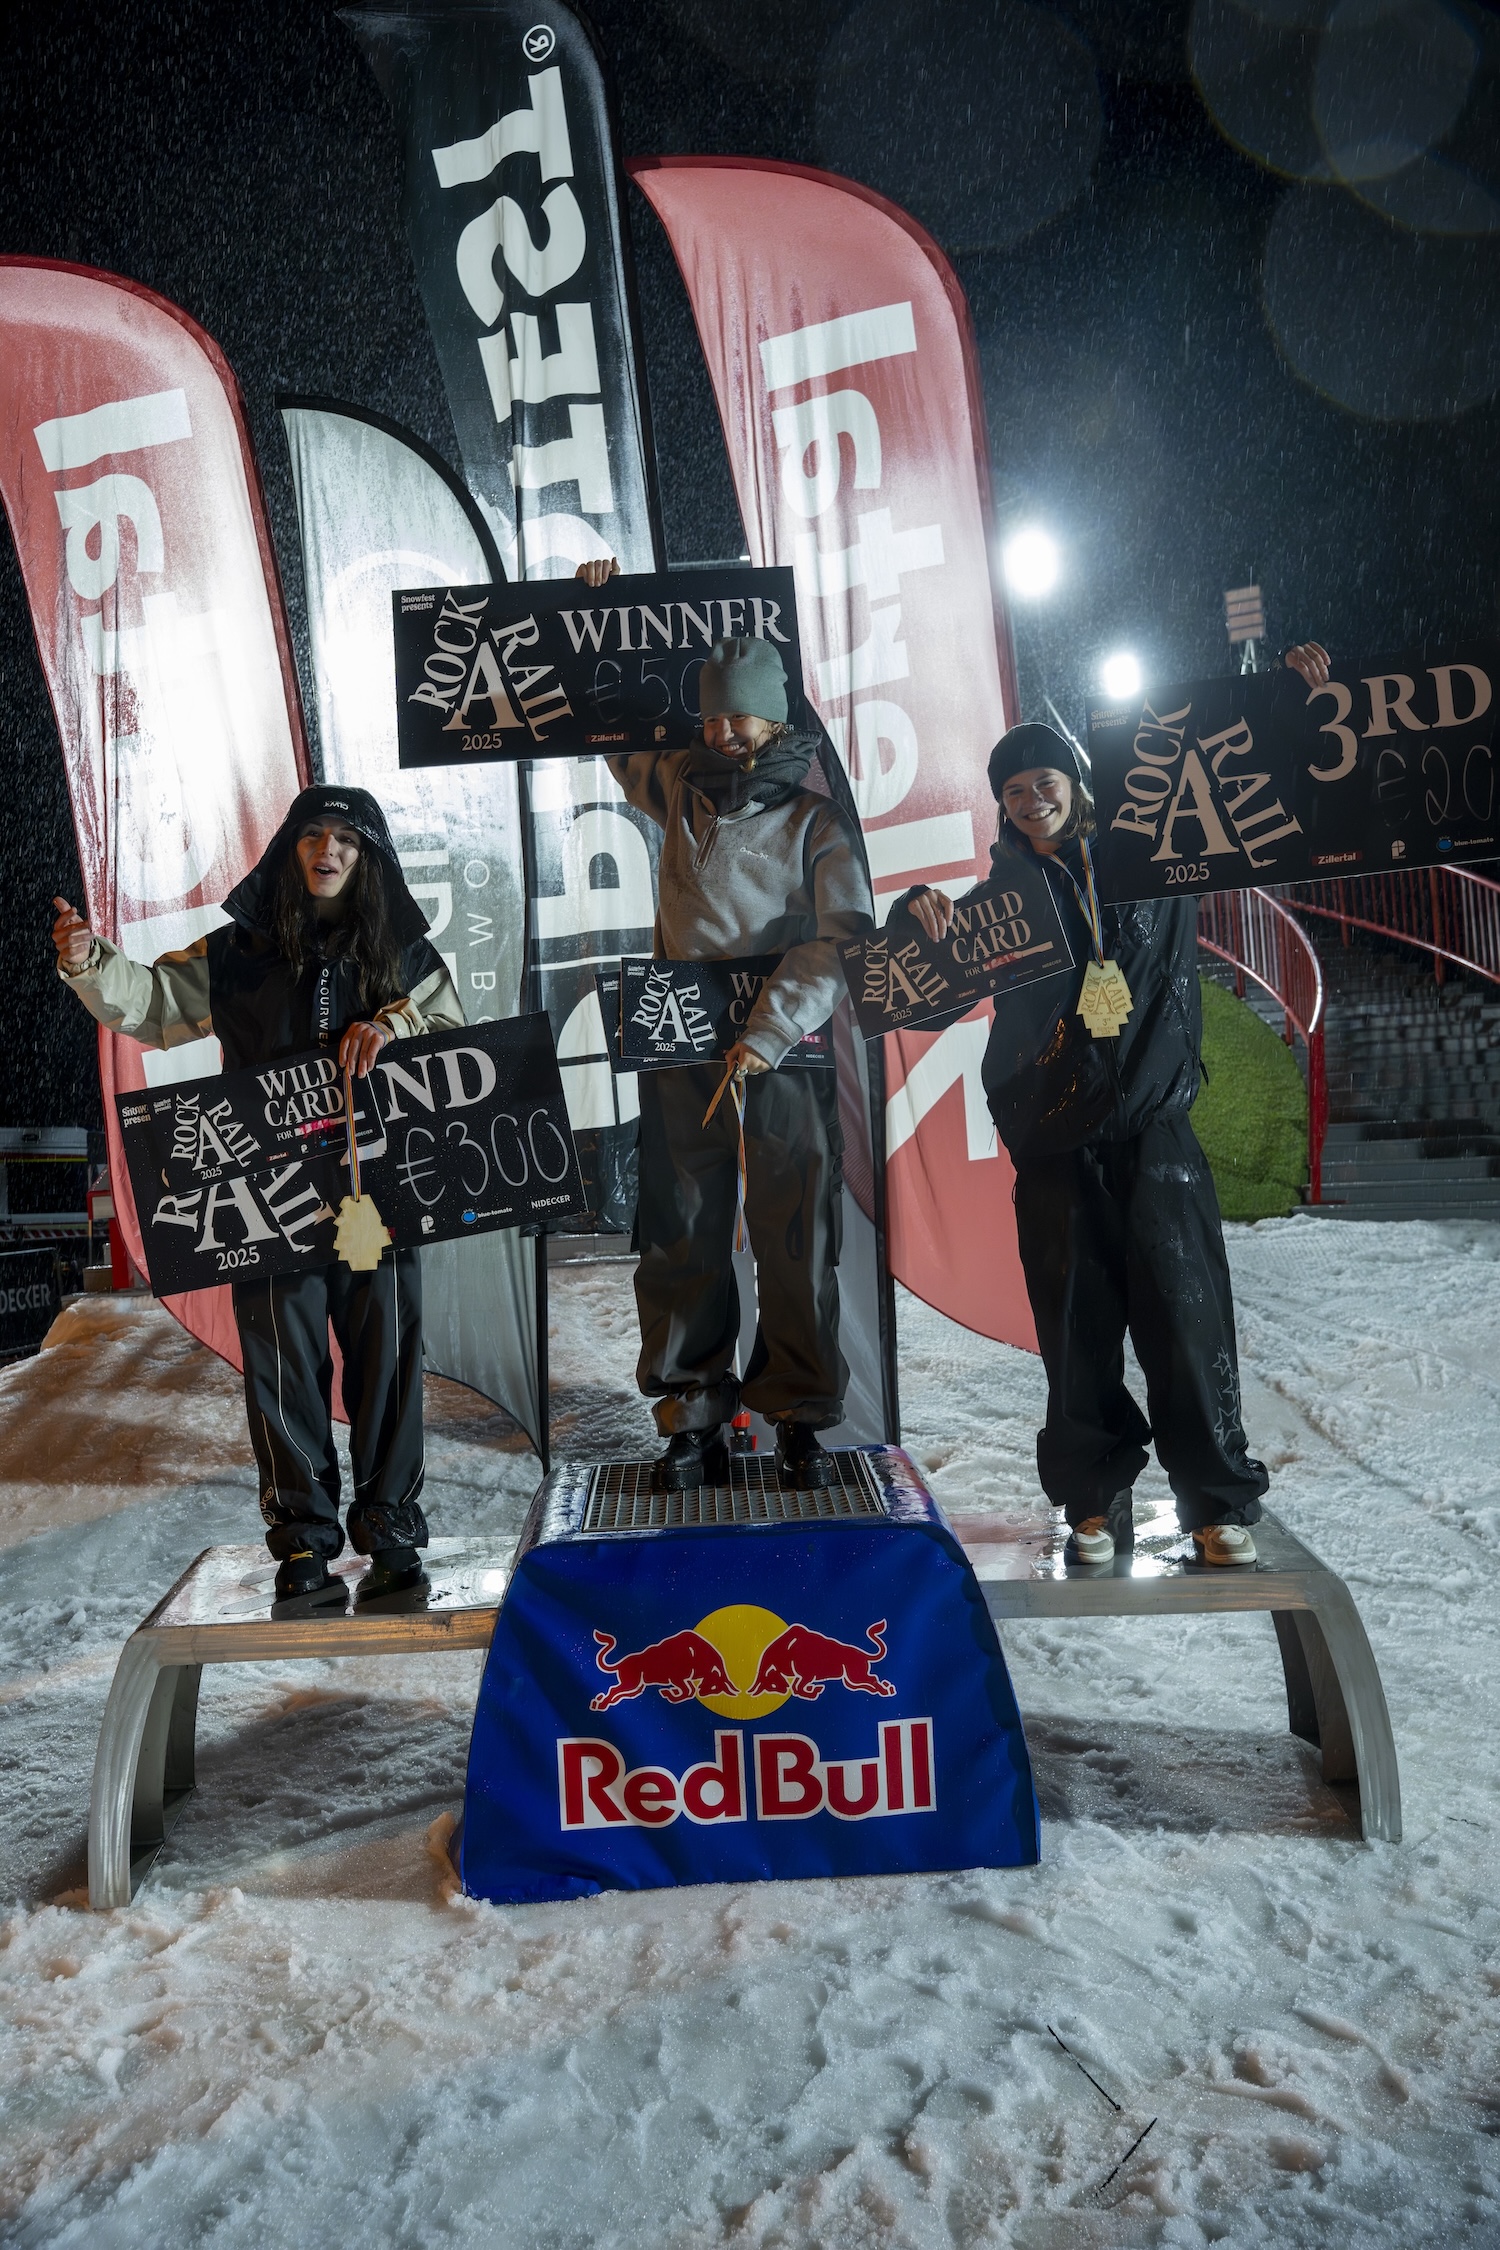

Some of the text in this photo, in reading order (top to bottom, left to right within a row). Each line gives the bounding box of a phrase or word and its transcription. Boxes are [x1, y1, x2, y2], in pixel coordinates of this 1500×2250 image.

[401, 594, 435, 605] Snowfest
[401, 601, 433, 613] presents
[558, 597, 791, 654] WINNER
[407, 590, 574, 742] ROCK A RAIL
[590, 733, 625, 743] Zillertal
[1091, 716, 1128, 731] presents
[1305, 663, 1493, 783] 3RD
[462, 733, 503, 752] 2025
[1110, 697, 1303, 869] ROCK A RAIL
[1453, 836, 1494, 848] blue-tomato
[1164, 862, 1210, 884] 2025
[1317, 852, 1356, 866] Zillertal
[949, 891, 1025, 938] WILD
[952, 918, 1033, 964] CARD
[861, 937, 950, 1013] ROCK A RAIL
[965, 966, 982, 979] FOR
[318, 966, 330, 1049] OLOURWEA
[630, 964, 674, 1030] ROCK
[1081, 973, 1128, 1015] ROCK A RAIL
[648, 991, 692, 1044] A
[676, 982, 719, 1052] RAIL
[891, 1007, 914, 1023] 2025
[655, 1042, 676, 1052] 2025
[256, 1056, 338, 1100] WILD
[122, 1104, 149, 1117] Snow
[123, 1113, 152, 1128] presen
[263, 1086, 345, 1129] CARD
[171, 1092, 261, 1171] ROCK A RAIL
[276, 1129, 293, 1142] FOR
[200, 1166, 222, 1181] 2025
[396, 1108, 569, 1206] €300
[194, 1176, 280, 1254] A
[258, 1162, 338, 1254] AIL
[477, 1207, 512, 1219] blue-tomato
[531, 1194, 571, 1209] NIDECKER
[216, 1246, 260, 1271] 2025
[557, 1717, 936, 1830] Red Bull
